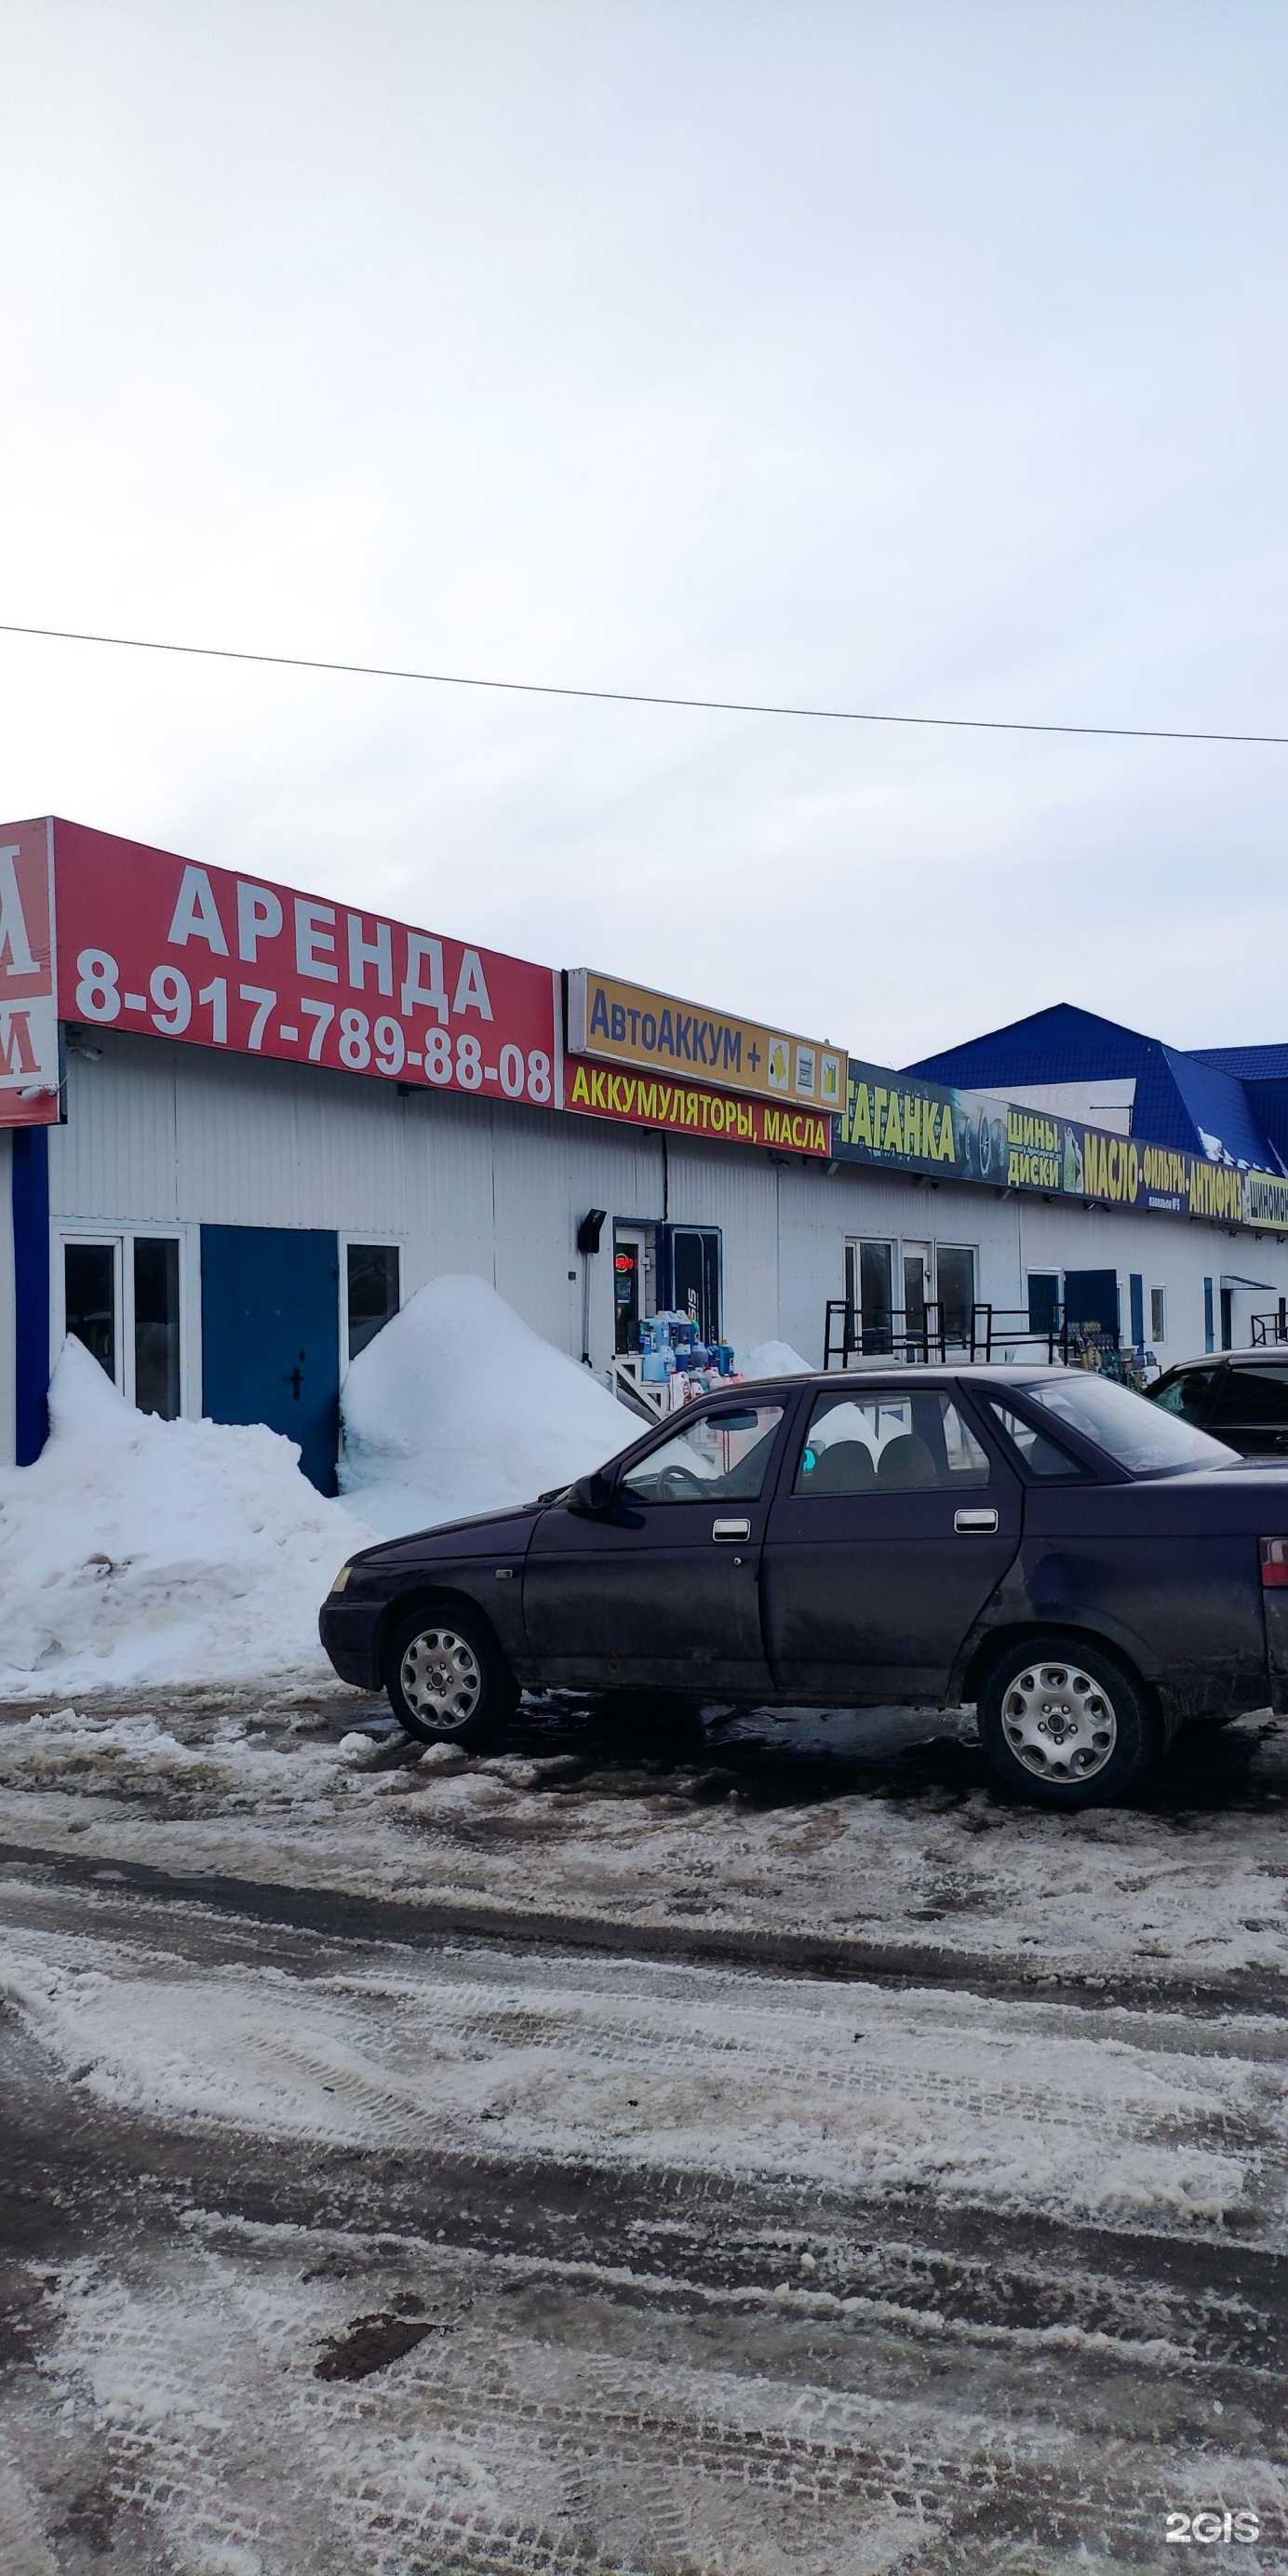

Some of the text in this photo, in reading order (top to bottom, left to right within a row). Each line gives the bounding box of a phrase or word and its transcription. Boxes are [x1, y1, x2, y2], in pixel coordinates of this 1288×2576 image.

[168, 865, 494, 1025] АРЕНДА
[75, 948, 552, 1103] 8-917-789-88-08
[571, 1067, 825, 1150] АККУМУЛЯТОРЫ, МАСЛА
[841, 1080, 956, 1163] ТАГАНКА
[1007, 1151, 1059, 1187] ДИСКИ
[1084, 1133, 1242, 1221] МАСЛО ФИЛЬТРЫ АНТИФРИЗ
